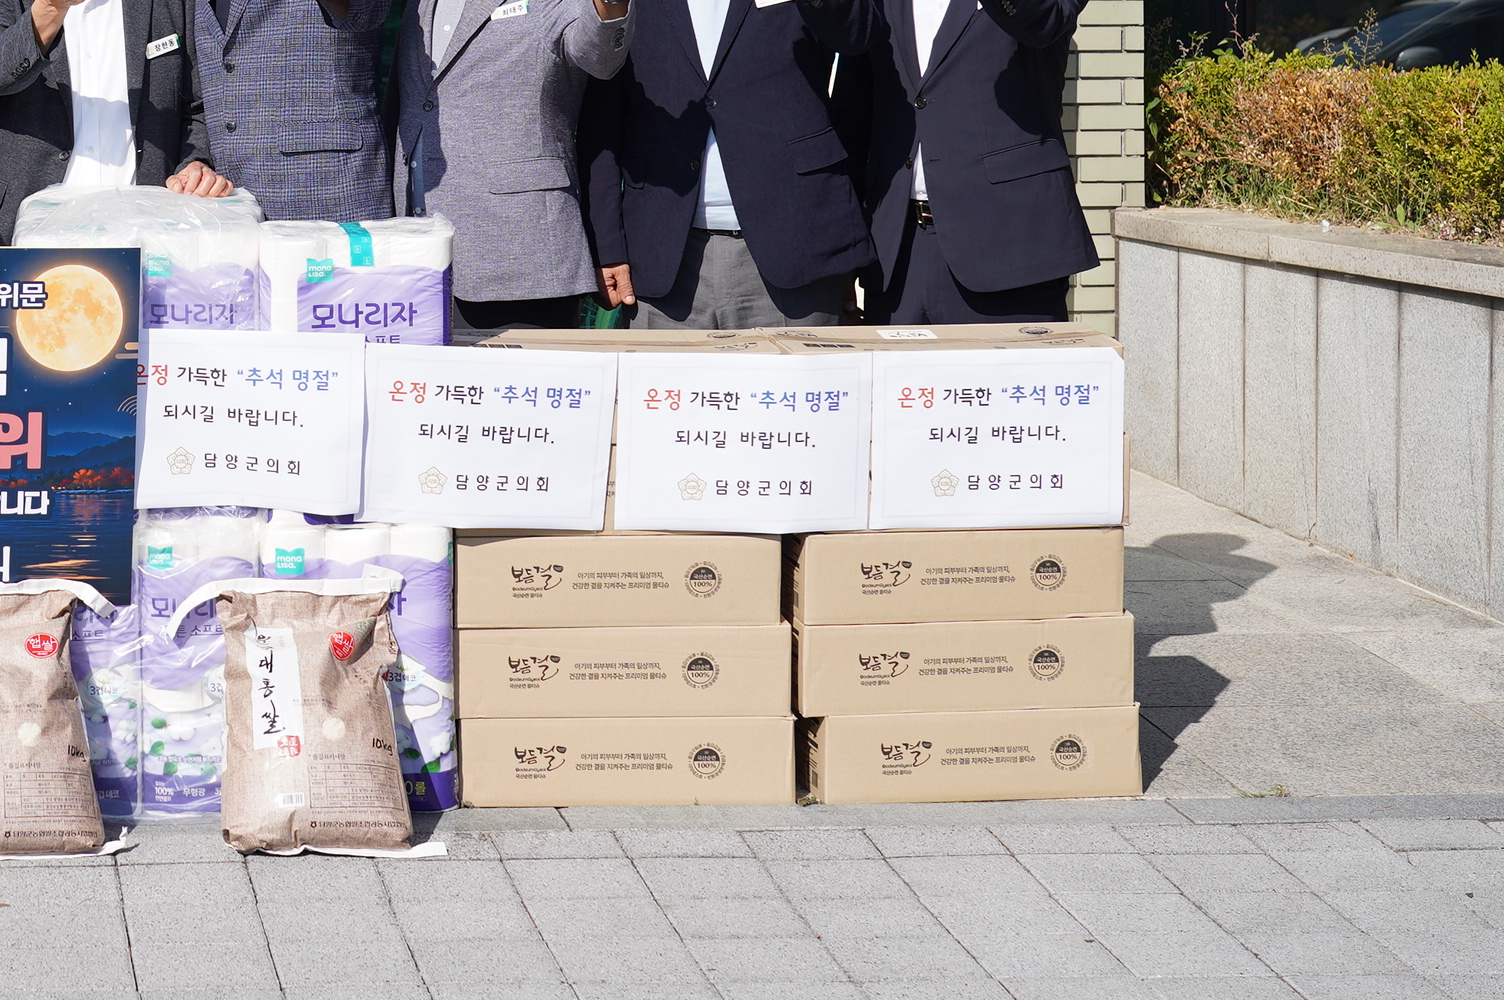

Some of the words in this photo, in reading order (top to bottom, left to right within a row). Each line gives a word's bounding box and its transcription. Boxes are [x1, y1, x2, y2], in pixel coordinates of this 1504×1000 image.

[149, 301, 236, 326] 모나리자
[311, 300, 418, 330] 모나리자
[136, 363, 169, 387] 온정
[176, 366, 228, 388] 가득한
[388, 380, 427, 404] 온정
[434, 384, 485, 406] 가득한
[642, 388, 681, 411] 온정
[689, 390, 741, 411] 가득한
[897, 386, 935, 409] 온정
[942, 386, 993, 407] 가득한
[162, 403, 214, 424] 되시길
[227, 407, 304, 428] 바랍니다.
[417, 423, 469, 444] 되시길
[481, 425, 555, 445] 바랍니다.
[674, 429, 727, 449] 되시길
[740, 431, 816, 450] 바랍니다.
[928, 426, 979, 445] 되시길
[991, 424, 1066, 444] 바랍니다.
[204, 452, 301, 476] 담양군의회
[456, 474, 549, 493] 담양군의회
[715, 479, 813, 497] 담양군의회
[967, 473, 1063, 491] 담양군의회
[572, 581, 590, 590] 건강한
[577, 572, 595, 580] 아기의
[692, 580, 713, 588] 100%
[1038, 573, 1058, 581] 100%
[27, 636, 59, 651] 햅쌀
[690, 671, 710, 679] 100%
[67, 744, 87, 763] 10kg
[372, 737, 394, 757] 10kg
[1058, 753, 1078, 761] 100%
